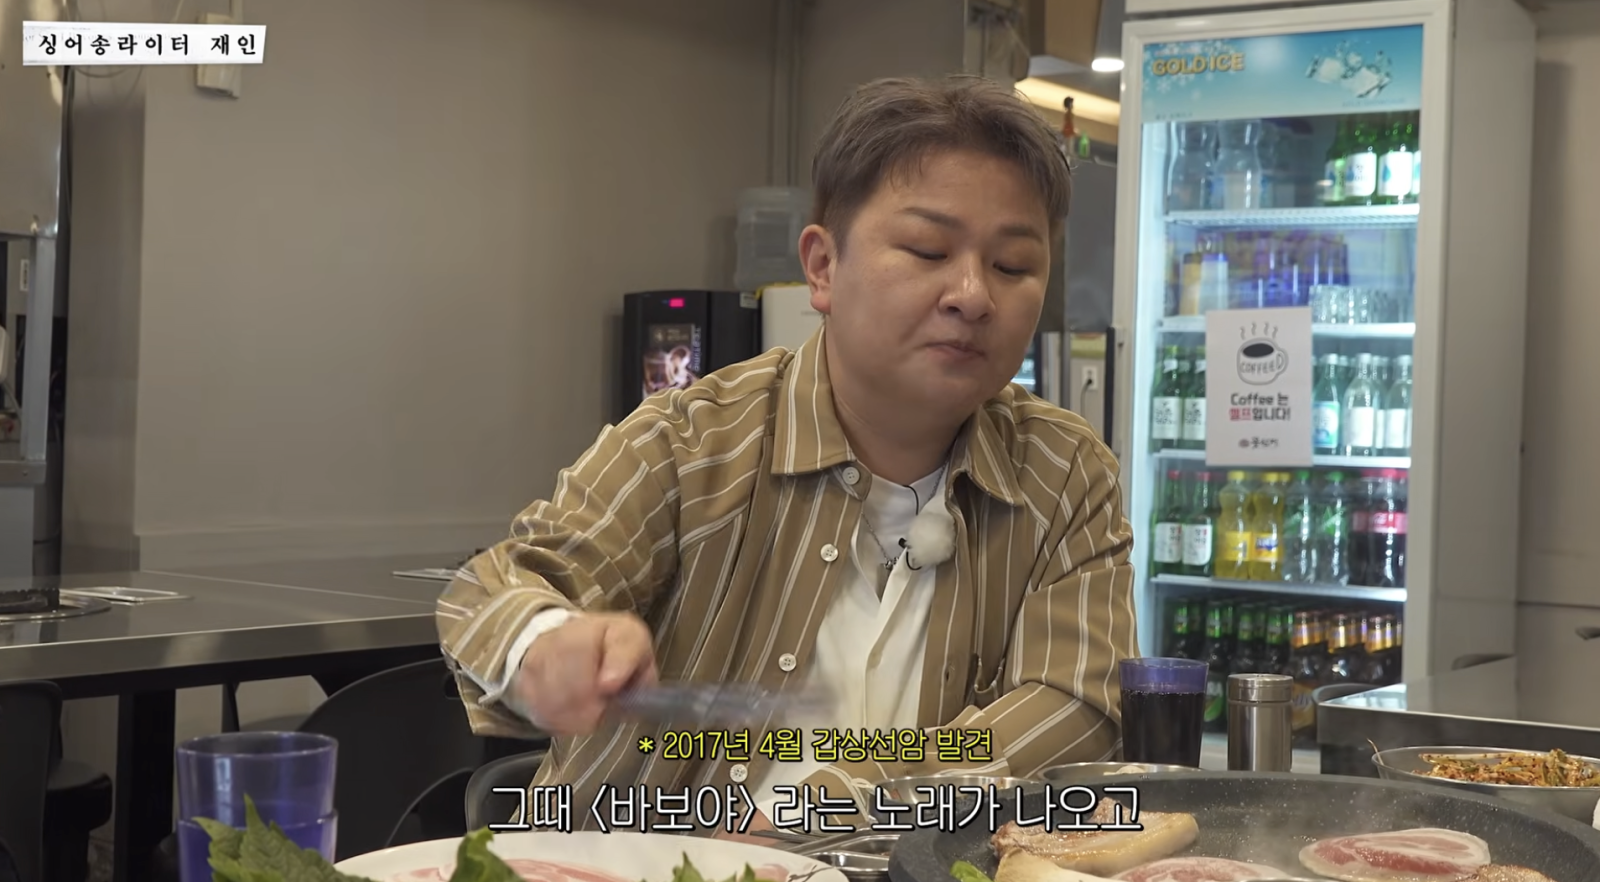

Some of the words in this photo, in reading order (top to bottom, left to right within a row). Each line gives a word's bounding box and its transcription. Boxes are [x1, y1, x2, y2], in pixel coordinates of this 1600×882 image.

[1152, 55, 1208, 76] GOLD
[1209, 52, 1246, 72] ICE
[1240, 360, 1276, 375] COFFEE
[1230, 392, 1274, 406] Coffee
[1277, 392, 1289, 406] 는
